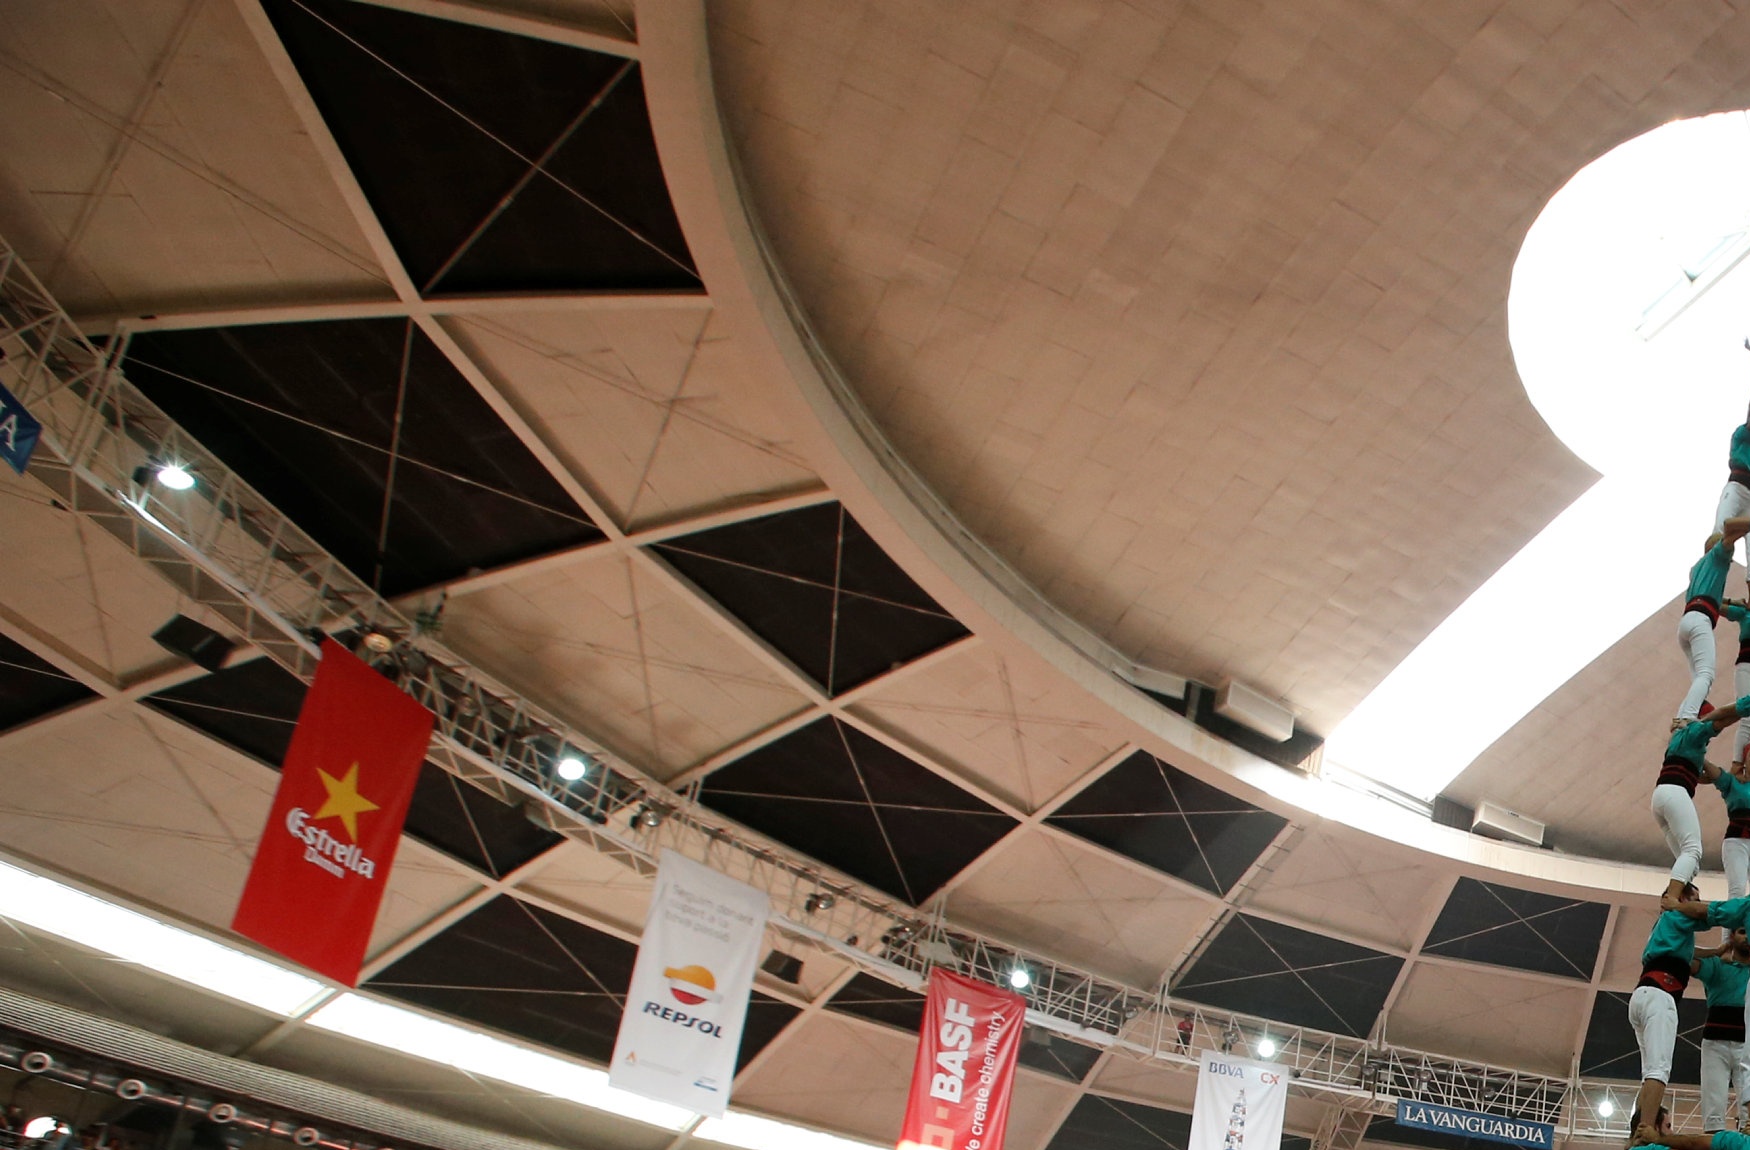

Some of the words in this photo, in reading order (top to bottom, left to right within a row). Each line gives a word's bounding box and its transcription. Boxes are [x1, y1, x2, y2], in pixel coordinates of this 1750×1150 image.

[286, 807, 375, 879] Estrella
[643, 1000, 723, 1039] REPSOL
[930, 997, 976, 1104] BASF
[979, 1010, 1006, 1086] chemistry
[1208, 1061, 1245, 1079] BBVA
[1260, 1072, 1281, 1085] CX
[970, 1087, 989, 1136] create
[1404, 1105, 1428, 1124] LA
[1428, 1109, 1546, 1144] VANGUARDIA
